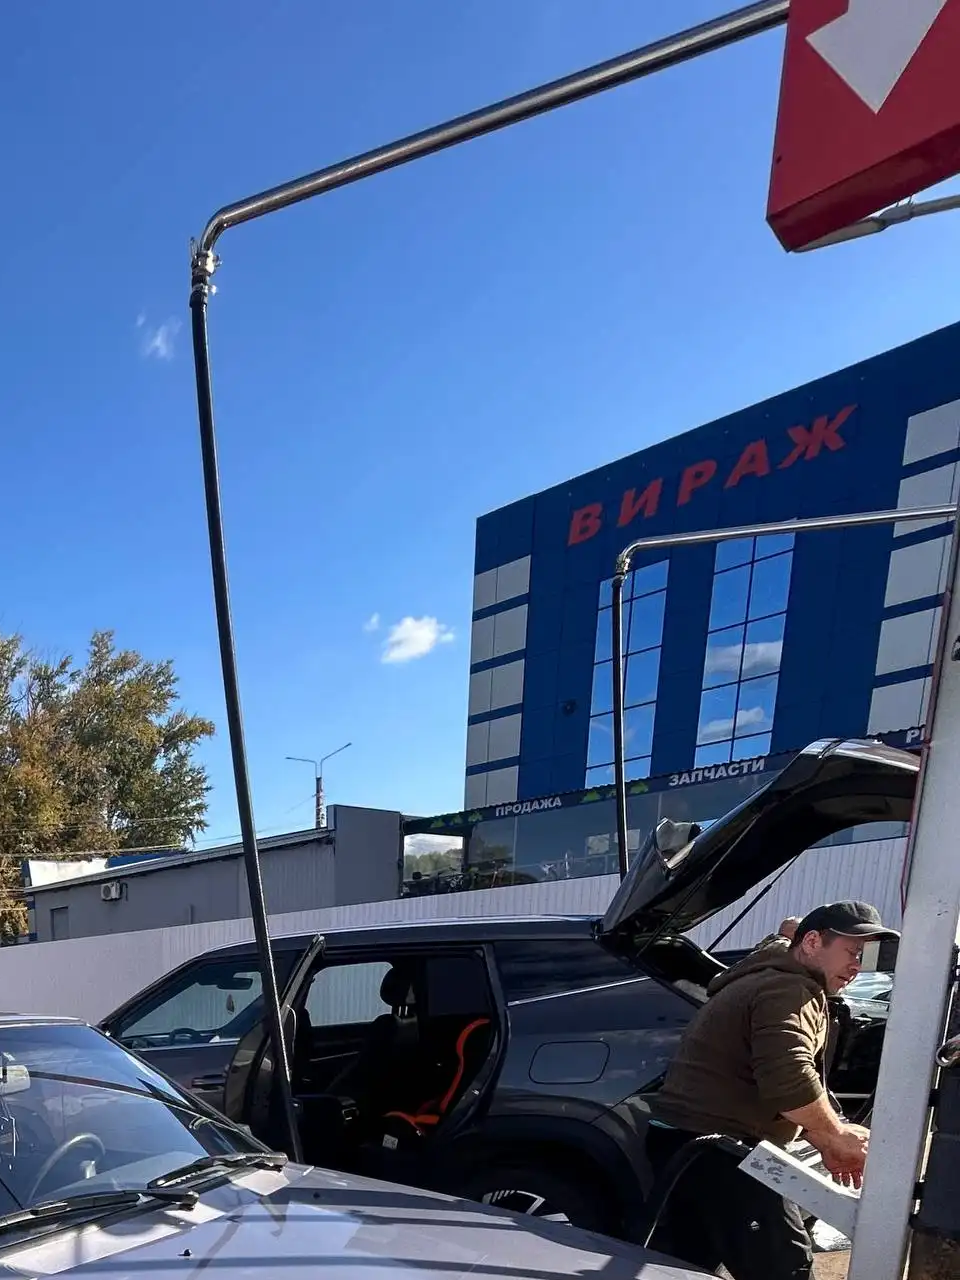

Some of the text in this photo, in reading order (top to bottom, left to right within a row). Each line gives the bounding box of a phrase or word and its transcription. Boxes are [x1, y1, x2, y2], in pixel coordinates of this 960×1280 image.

[568, 403, 858, 546] ВИРАЖ
[668, 758, 765, 787] ЗАПЧАСТИ
[495, 796, 562, 817] ПРОДАЖА
